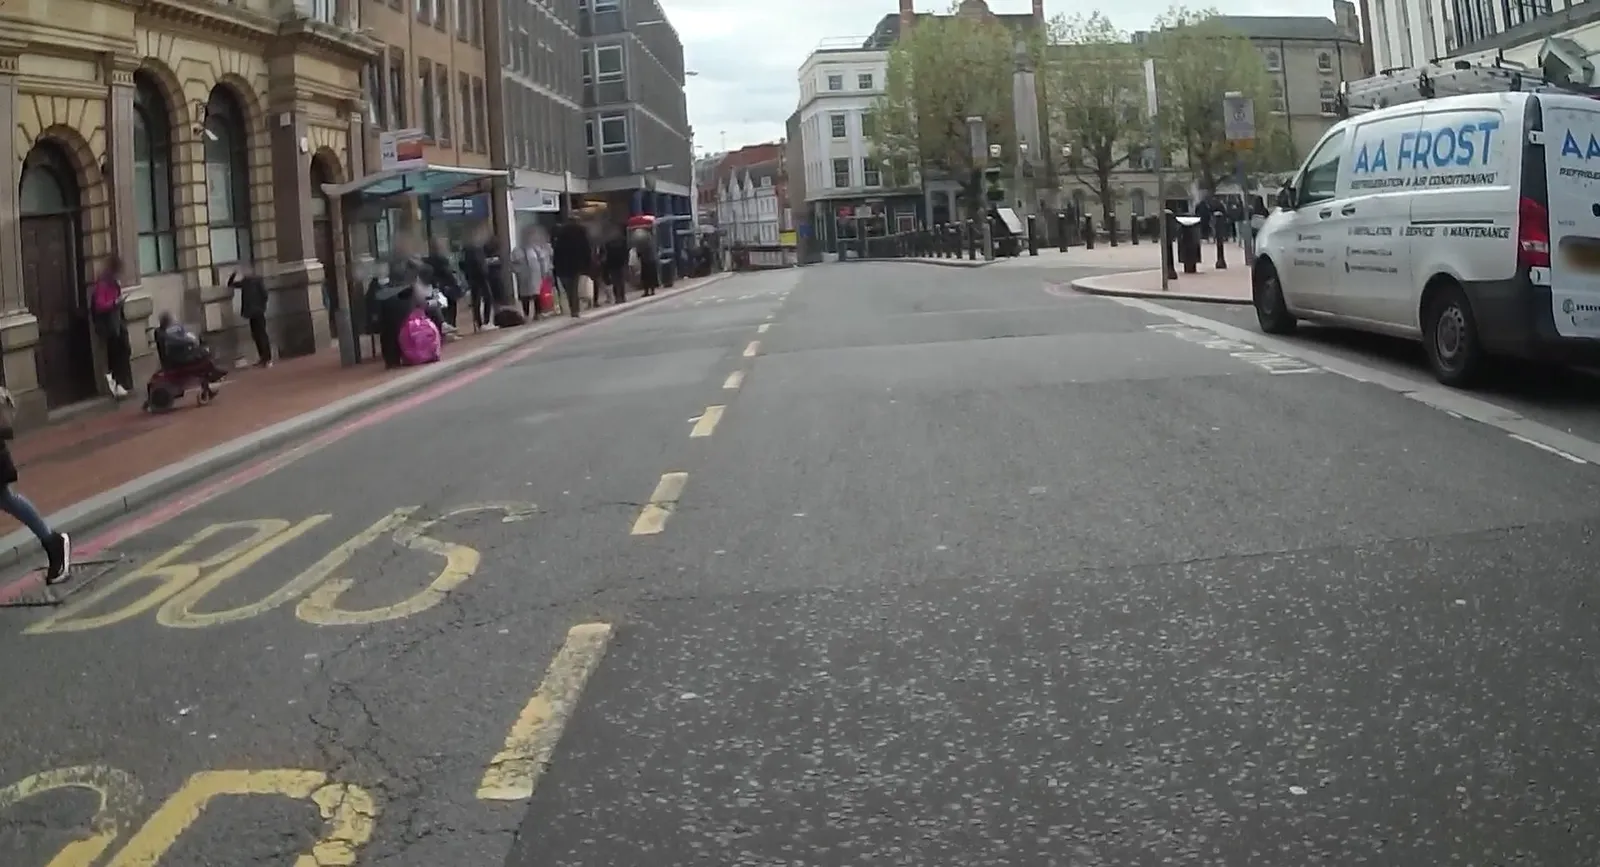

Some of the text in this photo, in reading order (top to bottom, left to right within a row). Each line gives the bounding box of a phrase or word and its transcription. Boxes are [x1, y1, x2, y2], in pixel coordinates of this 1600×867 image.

[1355, 121, 1499, 173] AA FROST
[1450, 226, 1511, 239] MAINTENANCE
[21, 501, 539, 635] BUS
